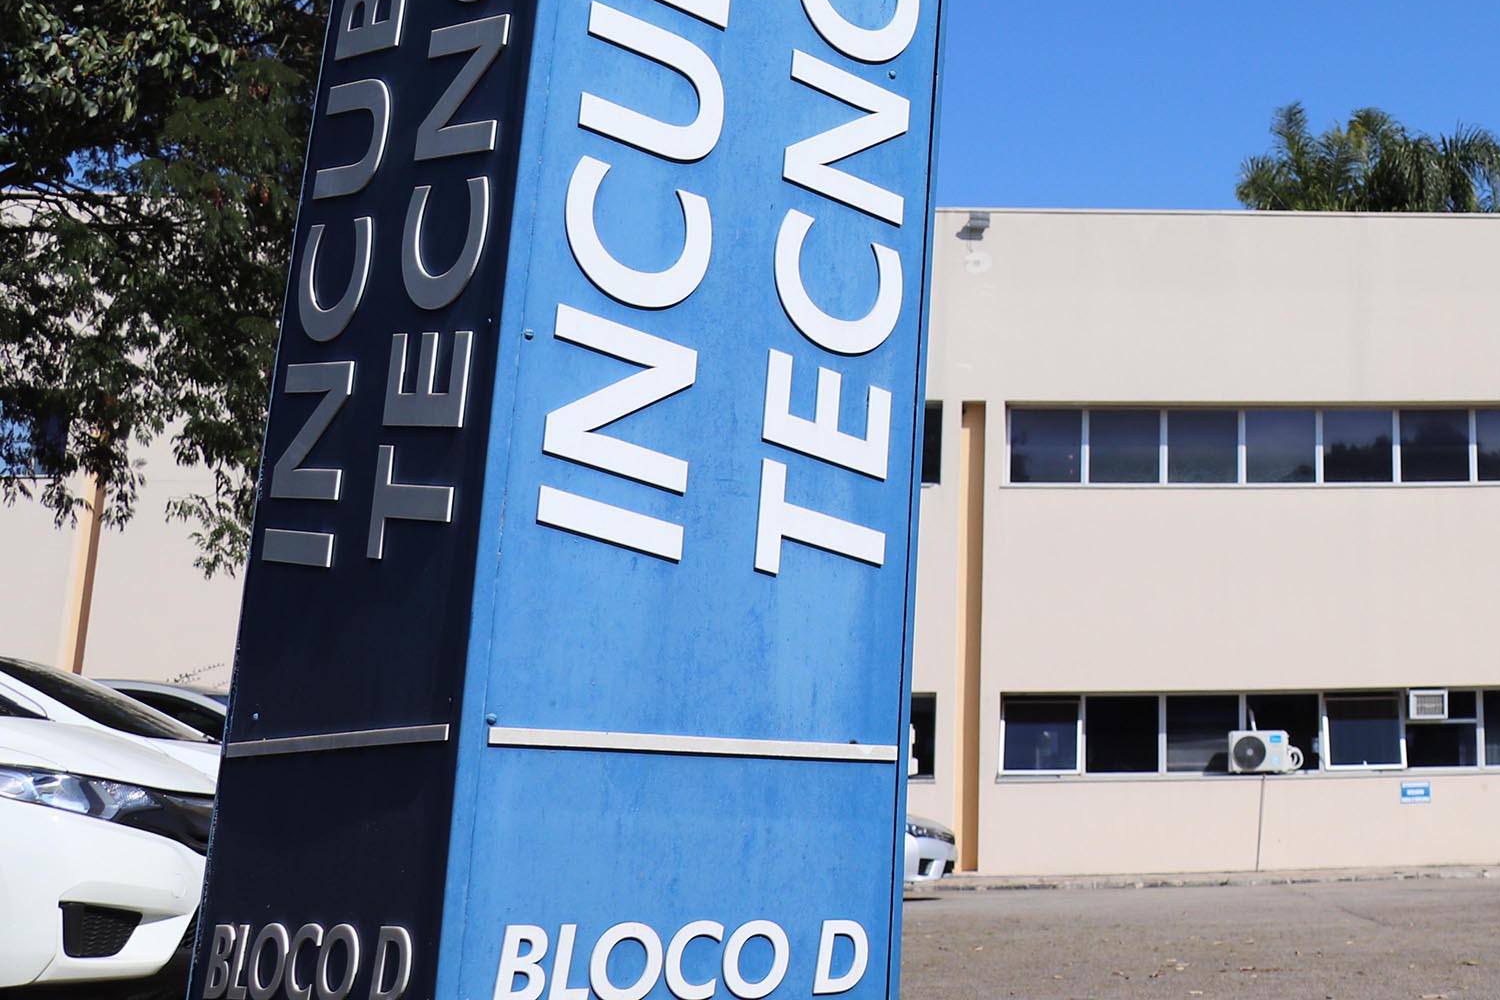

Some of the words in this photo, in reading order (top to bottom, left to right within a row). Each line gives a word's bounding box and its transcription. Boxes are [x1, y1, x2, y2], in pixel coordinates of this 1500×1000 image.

[203, 923, 360, 1000] BLOCO
[369, 925, 413, 1000] D
[493, 919, 790, 1000] BLOCO
[812, 919, 869, 996] D
